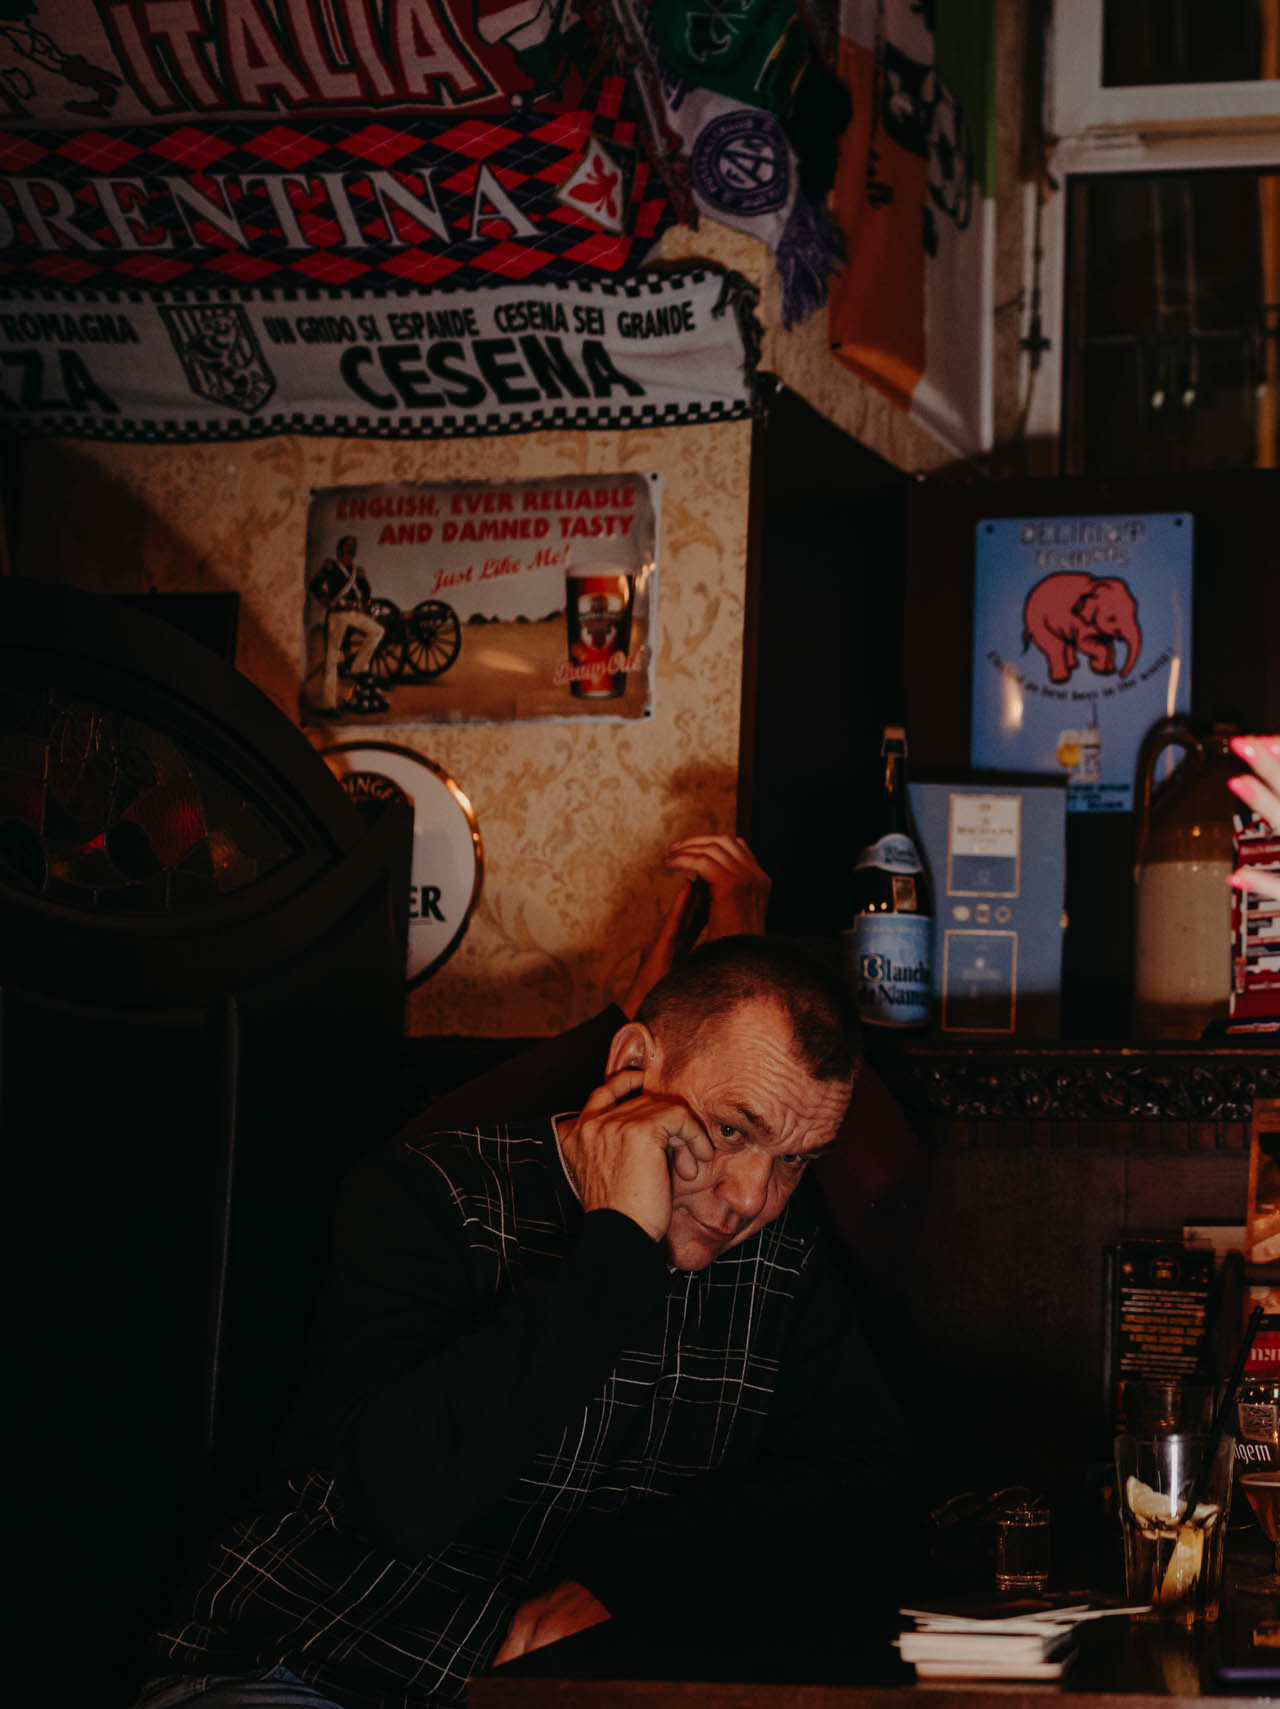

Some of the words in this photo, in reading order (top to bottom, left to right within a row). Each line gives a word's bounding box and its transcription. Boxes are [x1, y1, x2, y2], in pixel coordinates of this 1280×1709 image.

[104, 0, 487, 110] ITALIA
[3, 313, 140, 344] ROMAGNA
[262, 316, 296, 344] UN
[297, 316, 355, 344] GRIDO
[358, 314, 382, 342] SI
[387, 308, 479, 341] ESPANDE
[494, 301, 568, 334] CESENA
[573, 305, 605, 335] SEI
[617, 301, 696, 339] GRANDE
[0, 348, 121, 414] ZA
[339, 335, 647, 410] CESENA
[336, 495, 440, 521] ENGLISH,
[451, 491, 513, 515] EVER
[523, 487, 636, 512] RELIABLE
[378, 523, 433, 545] AND
[442, 517, 550, 543] DAMNED
[560, 514, 635, 538] TASTY
[431, 567, 473, 595] Just
[479, 556, 521, 580] Like
[527, 543, 570, 570] Me!
